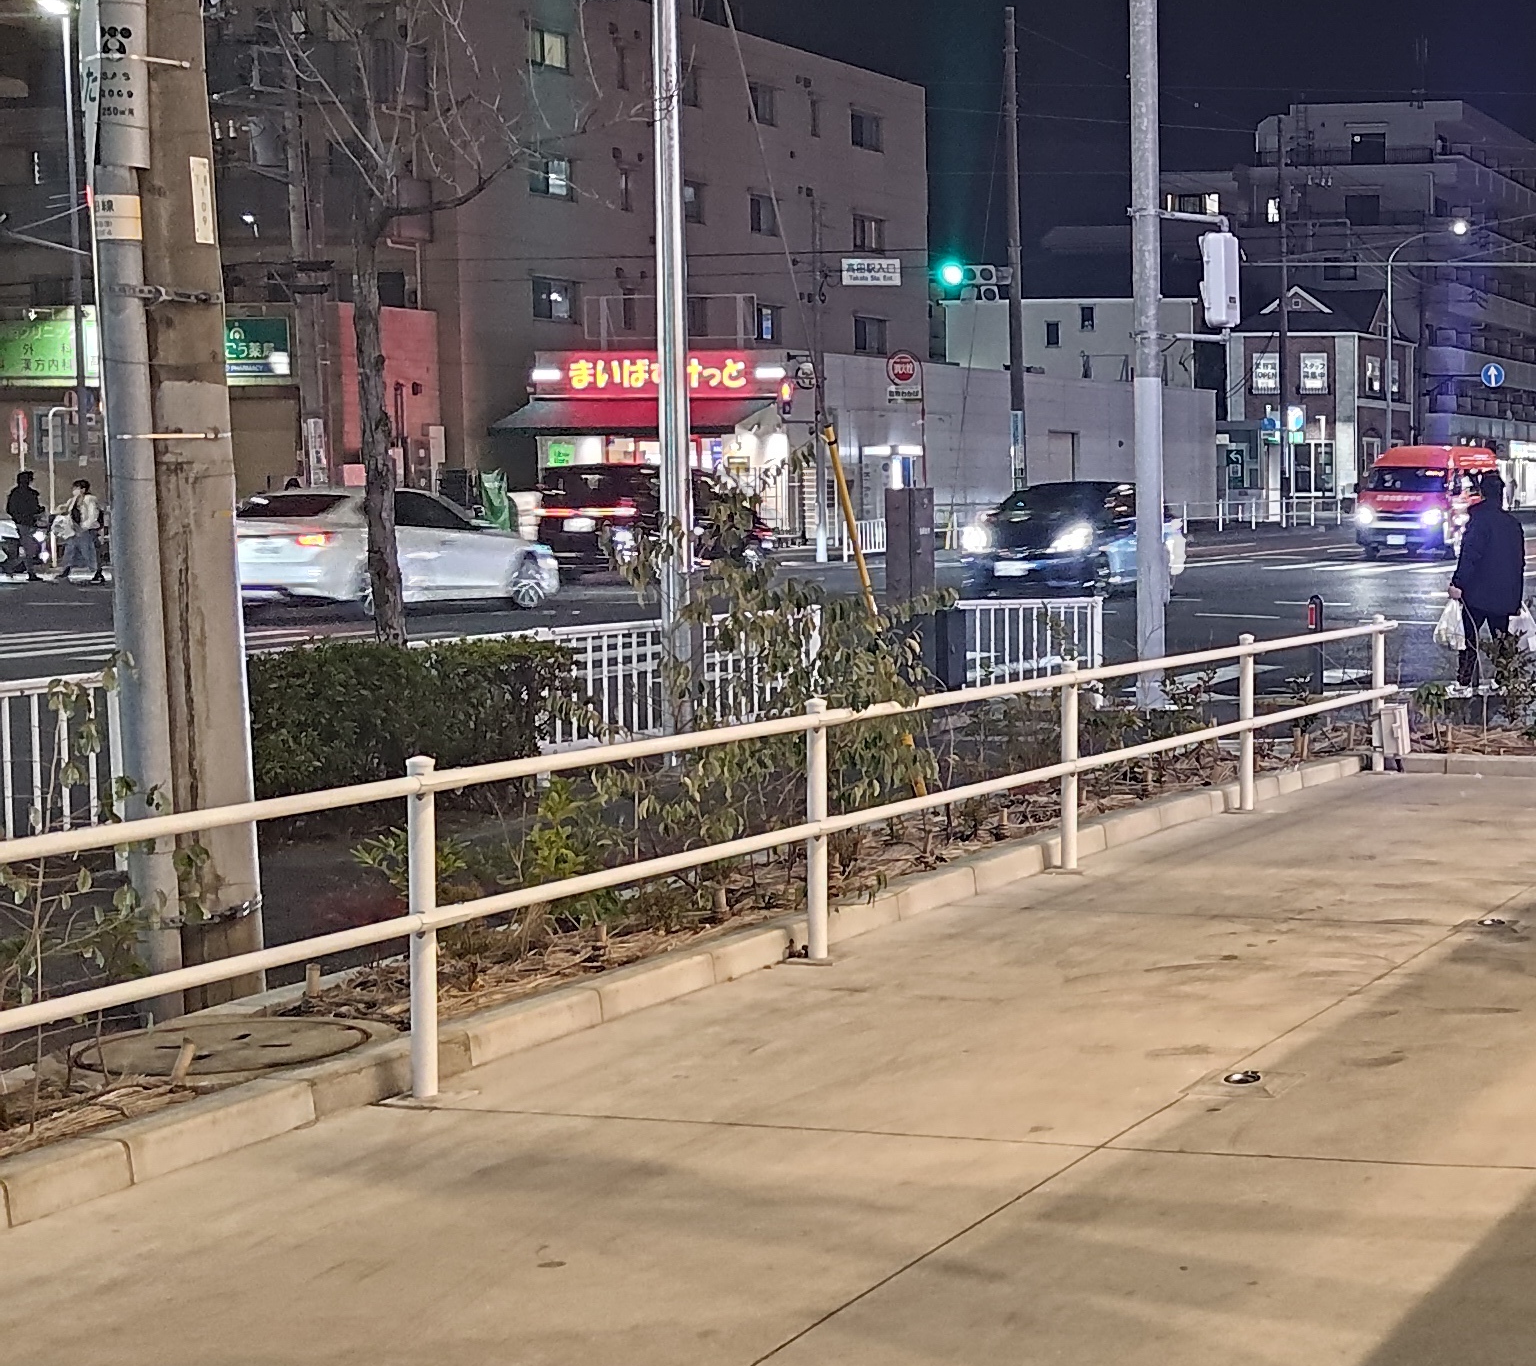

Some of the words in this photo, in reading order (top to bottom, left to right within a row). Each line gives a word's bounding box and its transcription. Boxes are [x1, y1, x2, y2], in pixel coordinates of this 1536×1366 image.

[846, 262, 896, 274] 高田駅入口
